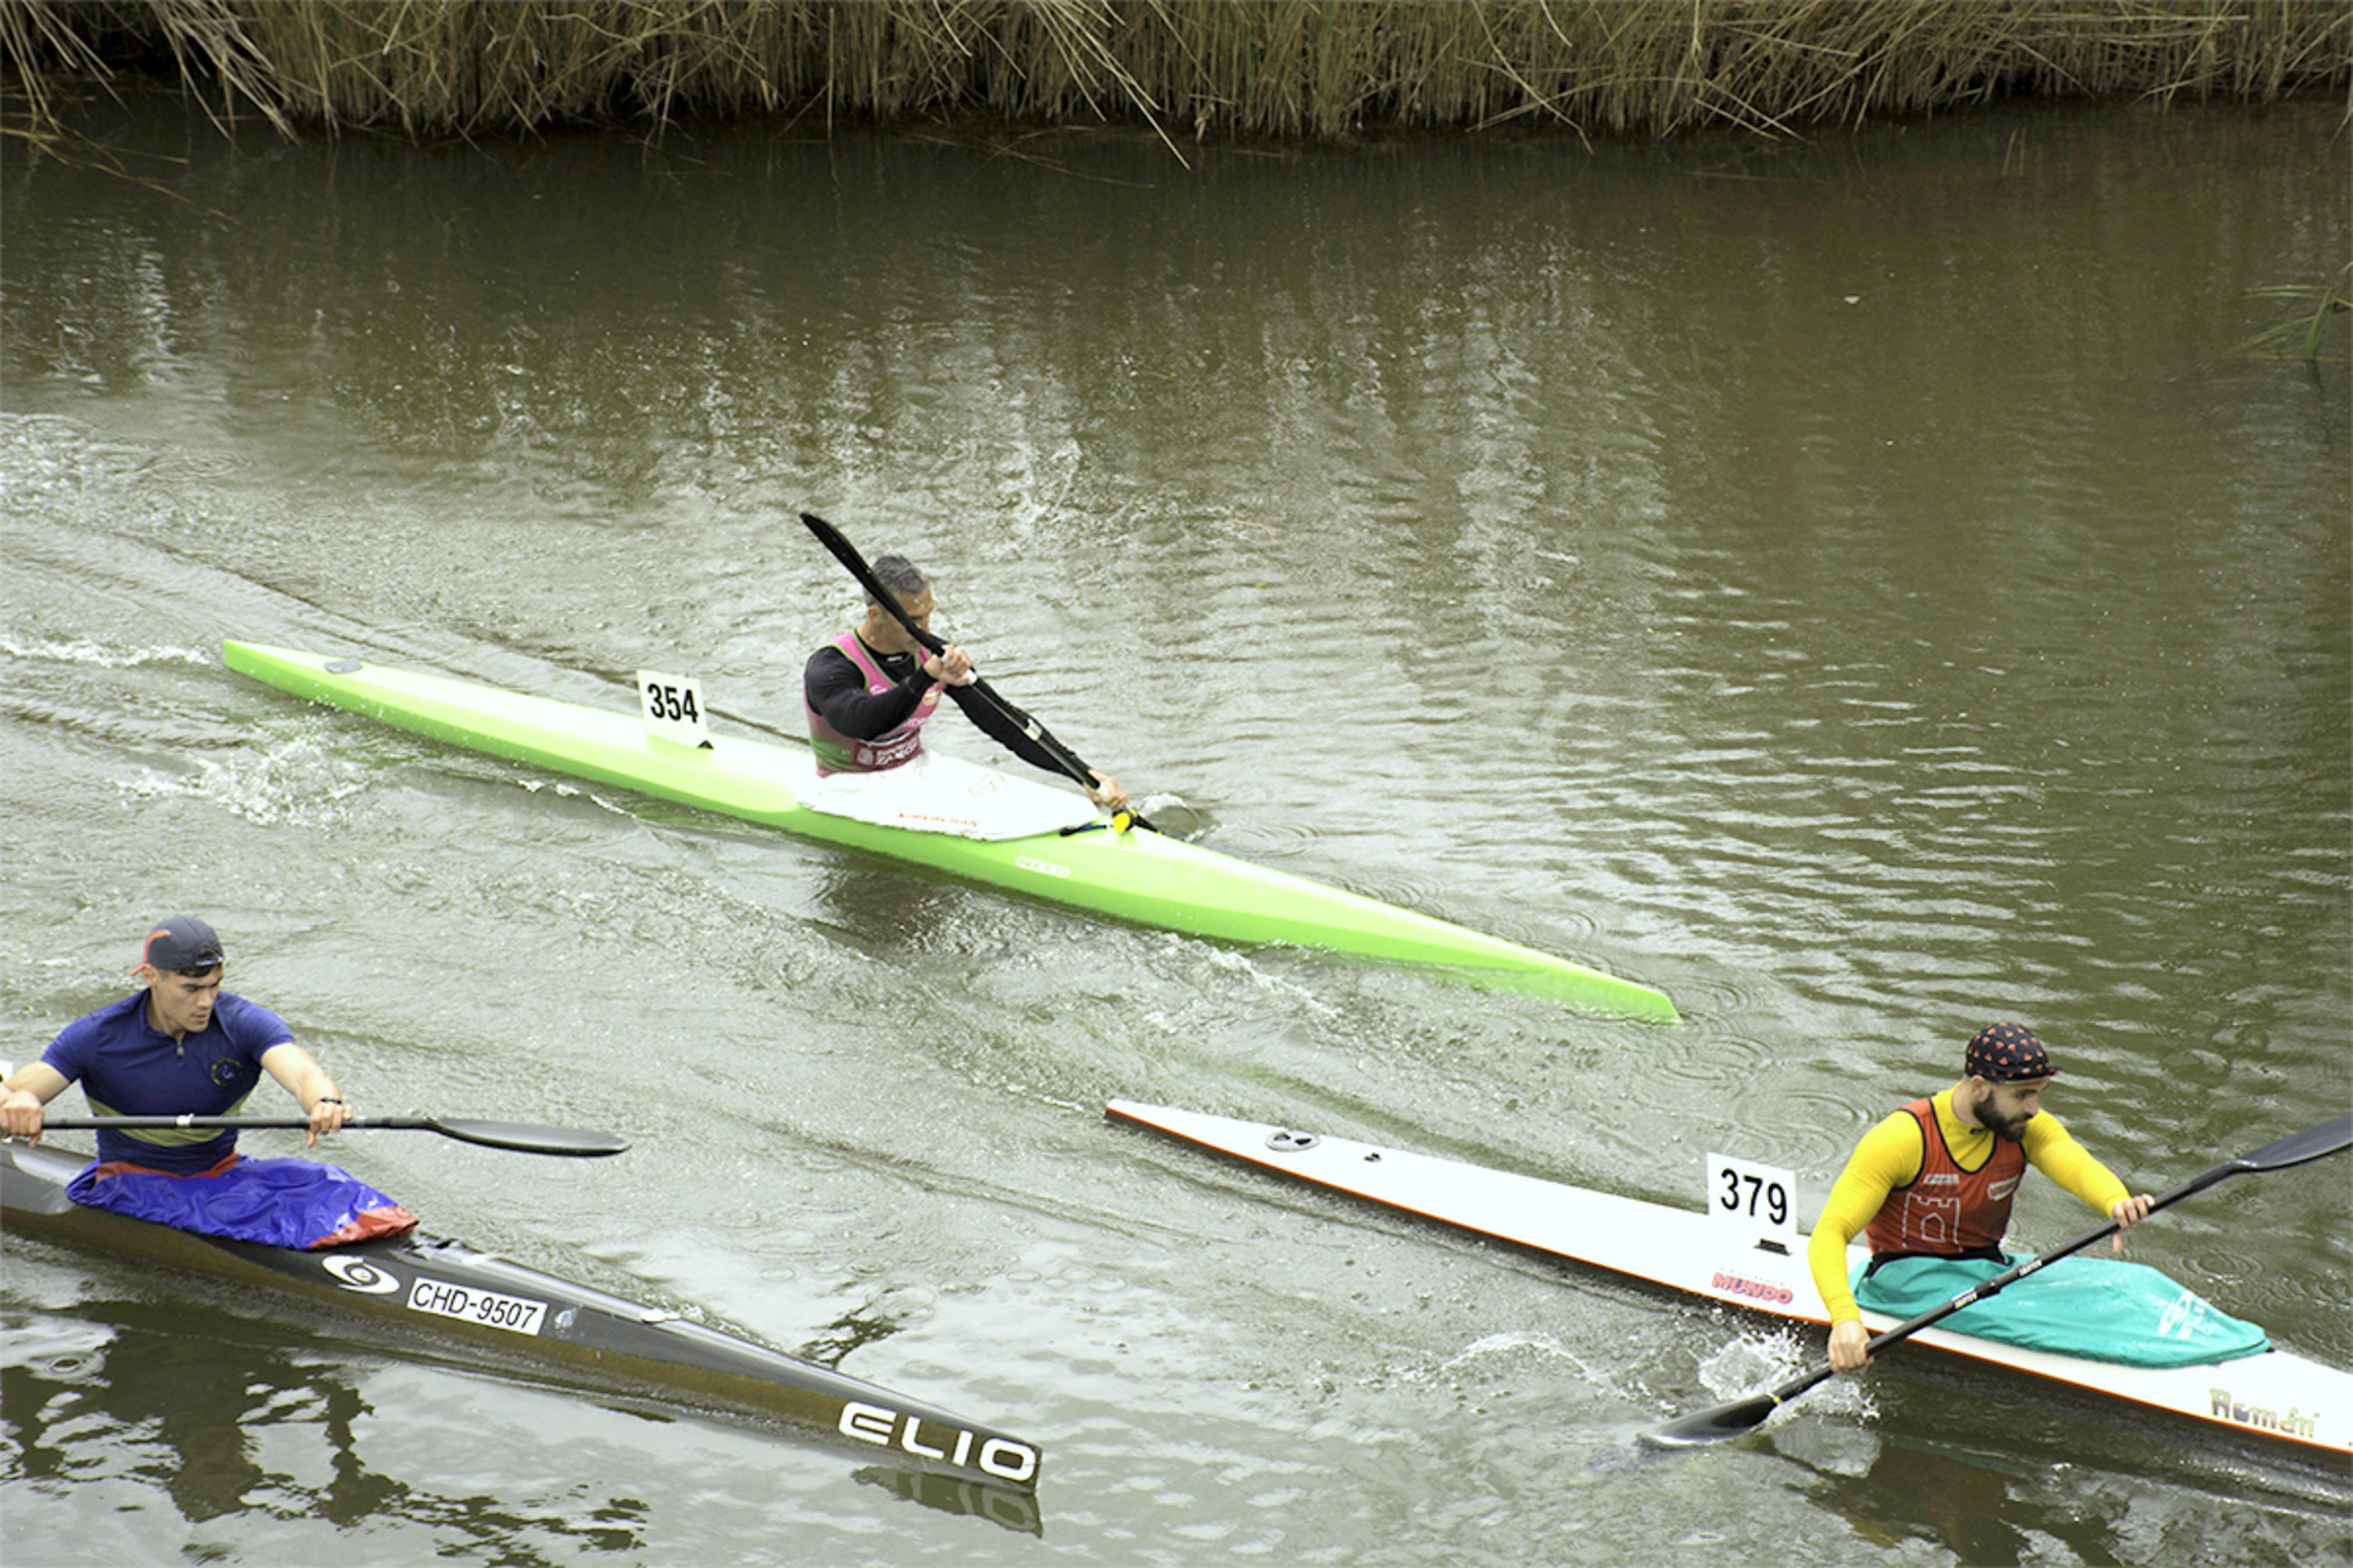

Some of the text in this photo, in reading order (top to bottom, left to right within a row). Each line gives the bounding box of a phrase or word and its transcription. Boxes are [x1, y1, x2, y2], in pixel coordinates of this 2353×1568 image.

[648, 683, 698, 723] 354
[1720, 1168, 1787, 1225] 379
[412, 1282, 538, 1329] CHD-9507
[1712, 1271, 1793, 1304] MUNDO
[838, 1401, 1036, 1482] ELIO
